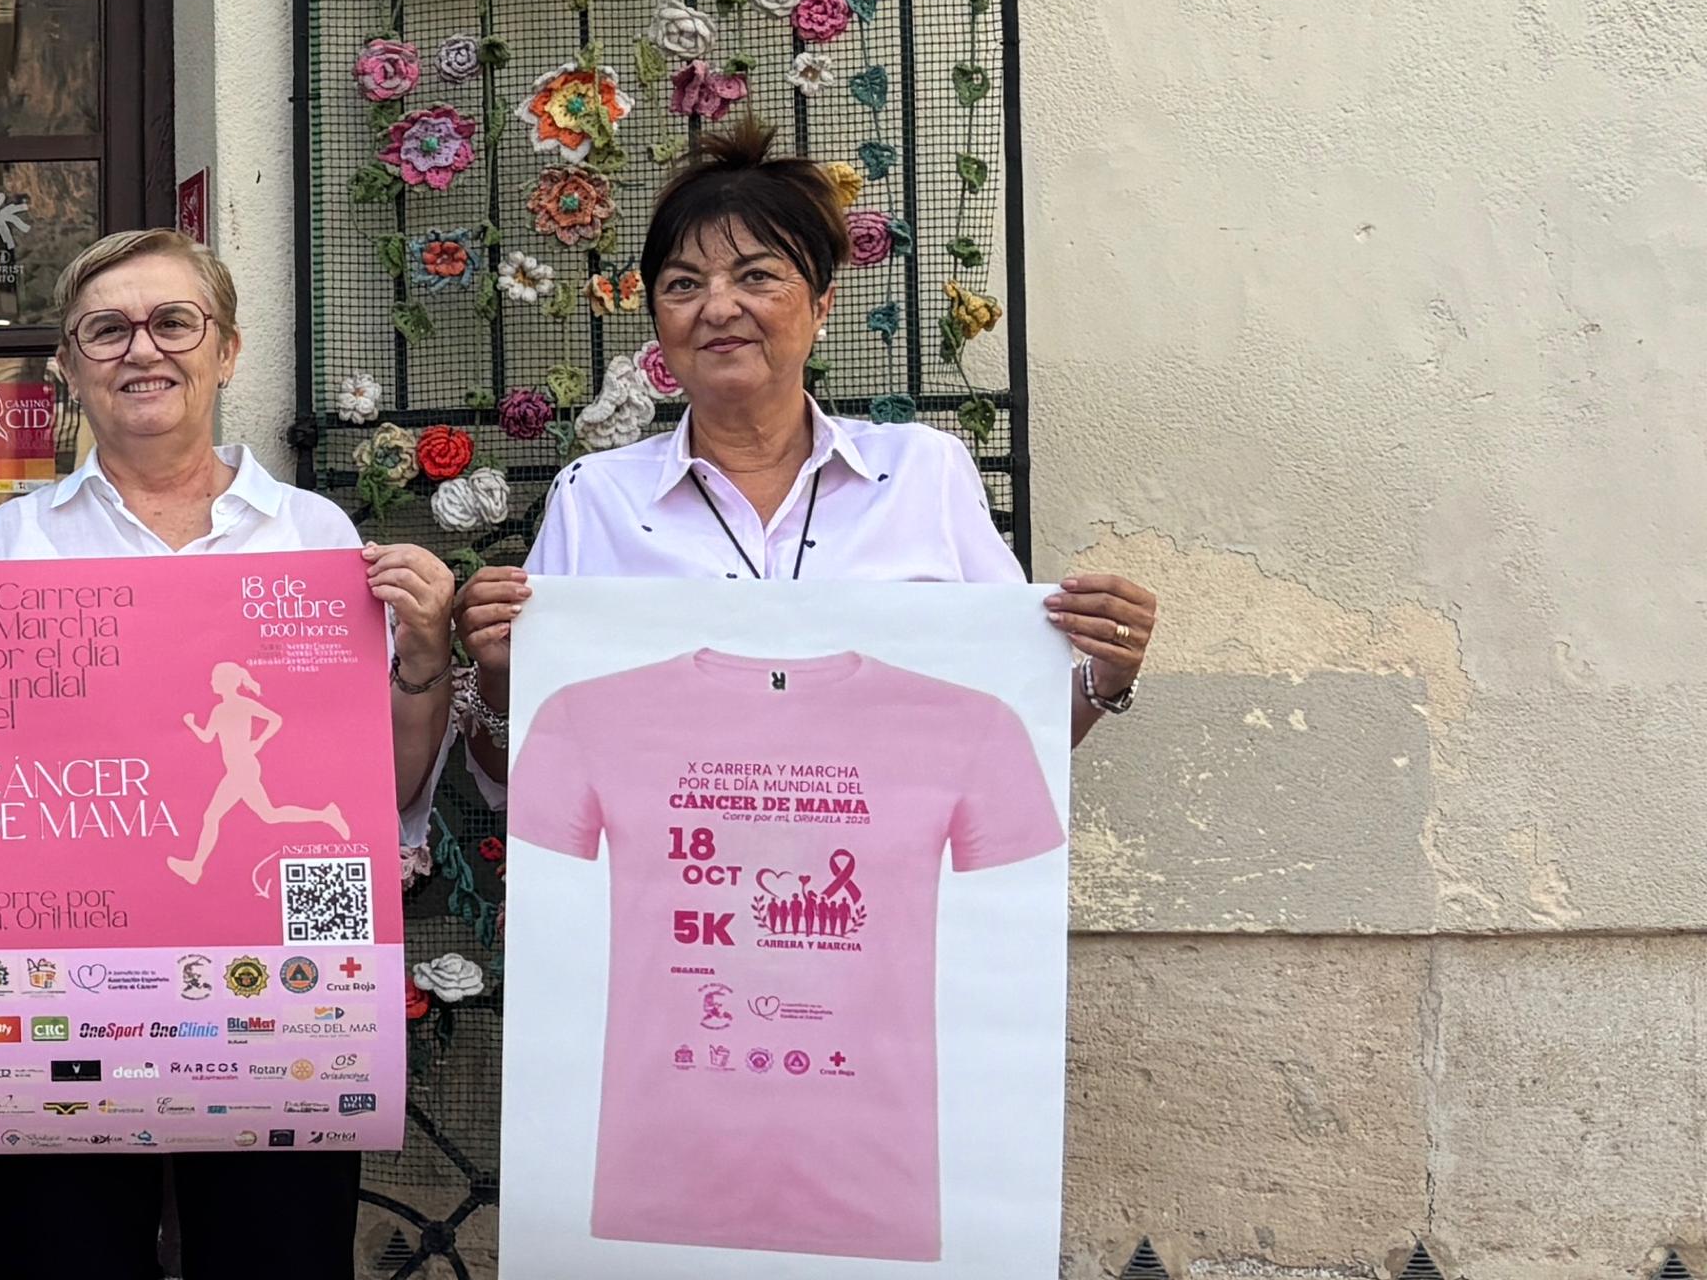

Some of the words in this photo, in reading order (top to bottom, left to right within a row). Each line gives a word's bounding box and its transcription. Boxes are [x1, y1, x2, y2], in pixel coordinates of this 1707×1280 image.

[5, 399, 50, 409] CAMINO
[5, 408, 50, 429] CID
[241, 576, 265, 599] 18
[272, 574, 306, 598] de
[242, 595, 346, 619] octubre
[300, 622, 349, 637] horas
[35, 638, 62, 669] el
[688, 761, 698, 775] X
[701, 761, 772, 776] CARRERA
[776, 764, 787, 776] Y
[790, 764, 859, 779] MARCHA
[678, 776, 709, 790] POR
[714, 777, 729, 791] EL
[734, 776, 759, 791] DÍA
[763, 779, 833, 794] MUNDIAL
[836, 781, 864, 795] DEL
[669, 792, 758, 812] CÁNCER
[762, 796, 791, 812] DE
[794, 797, 870, 815] MAMA
[40, 800, 180, 840] MAMA
[753, 813, 772, 823] por
[281, 843, 370, 855] INSCRIPCIONES
[668, 827, 716, 861] 18
[682, 865, 742, 886] OCT
[66, 890, 115, 915] por
[673, 910, 736, 946] 5K
[756, 938, 804, 950] CARRERA
[806, 940, 815, 950] Y
[817, 940, 862, 952] MARCHA
[326, 982, 350, 991] Cruz
[353, 982, 376, 992] Roja
[34, 1024, 66, 1036] CRC
[79, 1022, 145, 1040] OneSport
[150, 1022, 219, 1038] OneClinic
[227, 1017, 276, 1031] BigMat
[282, 1023, 322, 1034] PASEO
[323, 1023, 345, 1033] DEL
[349, 1022, 377, 1033] MAR
[170, 1062, 239, 1073] MARCOS
[249, 1064, 287, 1076] Rotary
